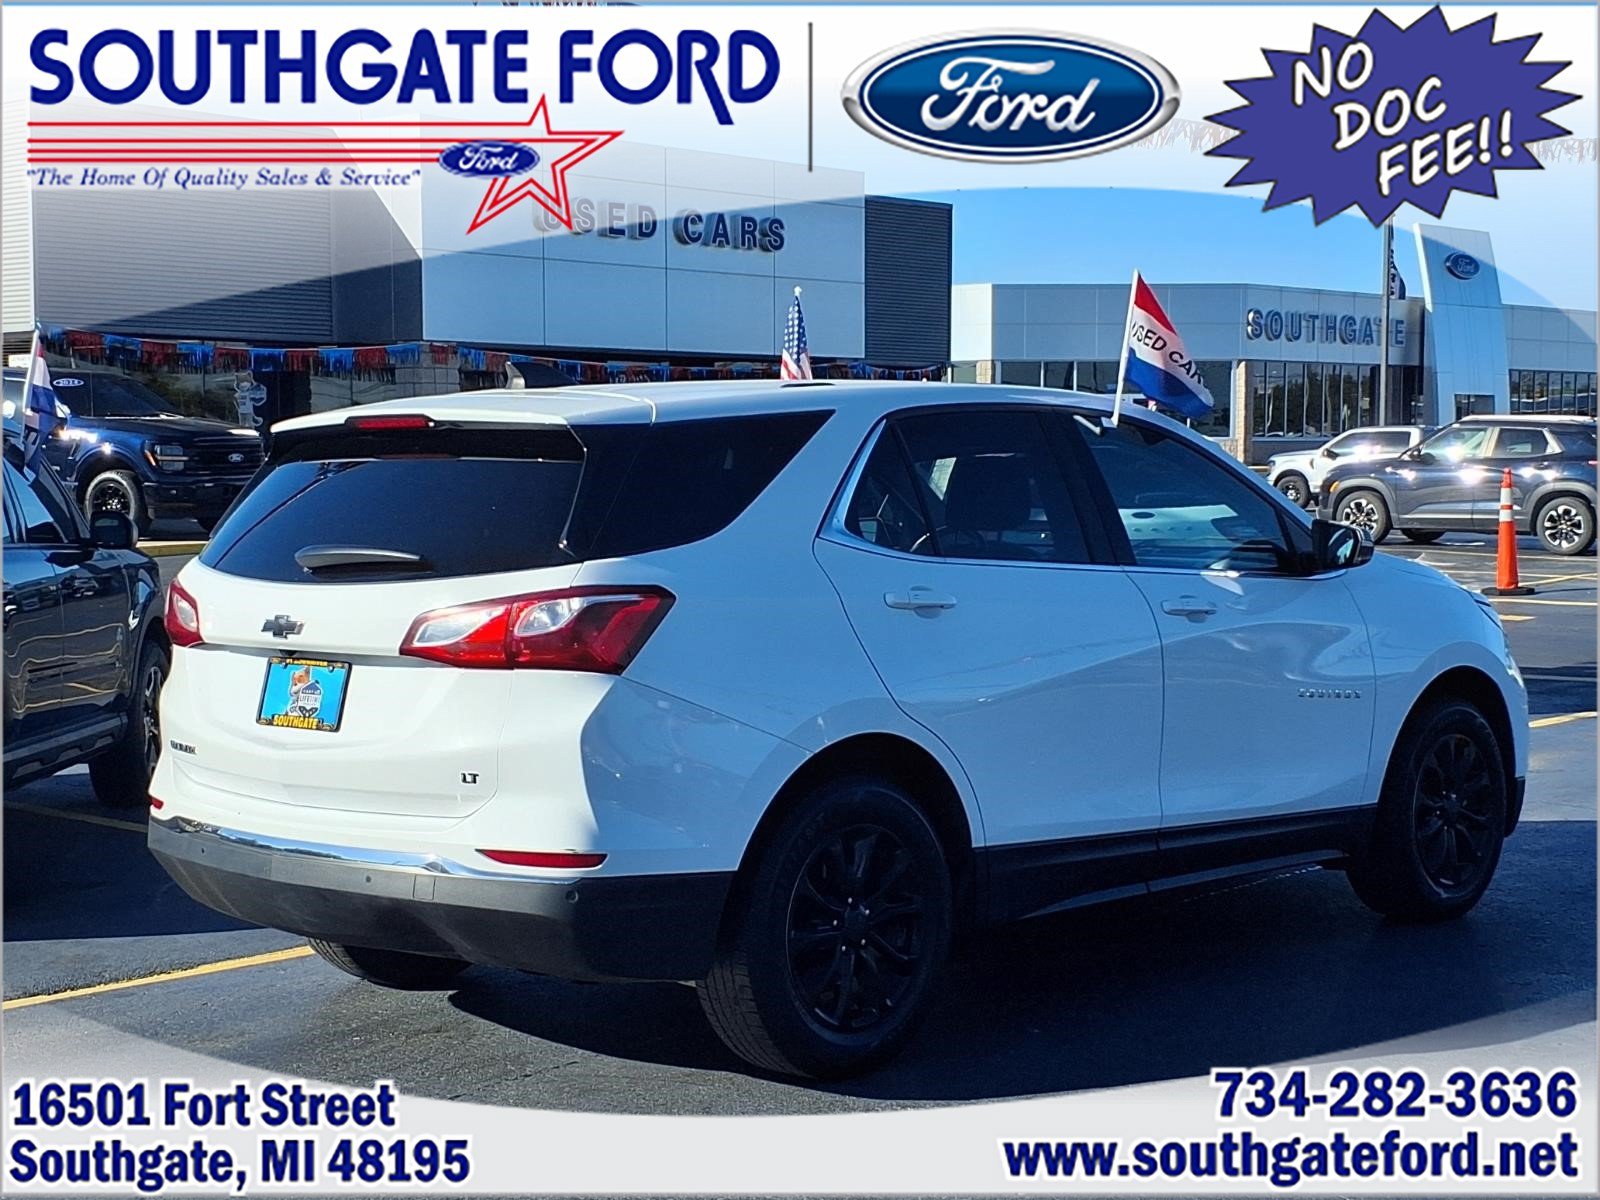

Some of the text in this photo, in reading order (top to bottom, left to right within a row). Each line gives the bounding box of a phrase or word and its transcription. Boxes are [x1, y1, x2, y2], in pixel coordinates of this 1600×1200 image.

[534, 197, 785, 252] USED CARS
[1168, 351, 1203, 384] CAR
[272, 714, 319, 730] SOUTHGATE
[461, 772, 479, 785] LT
